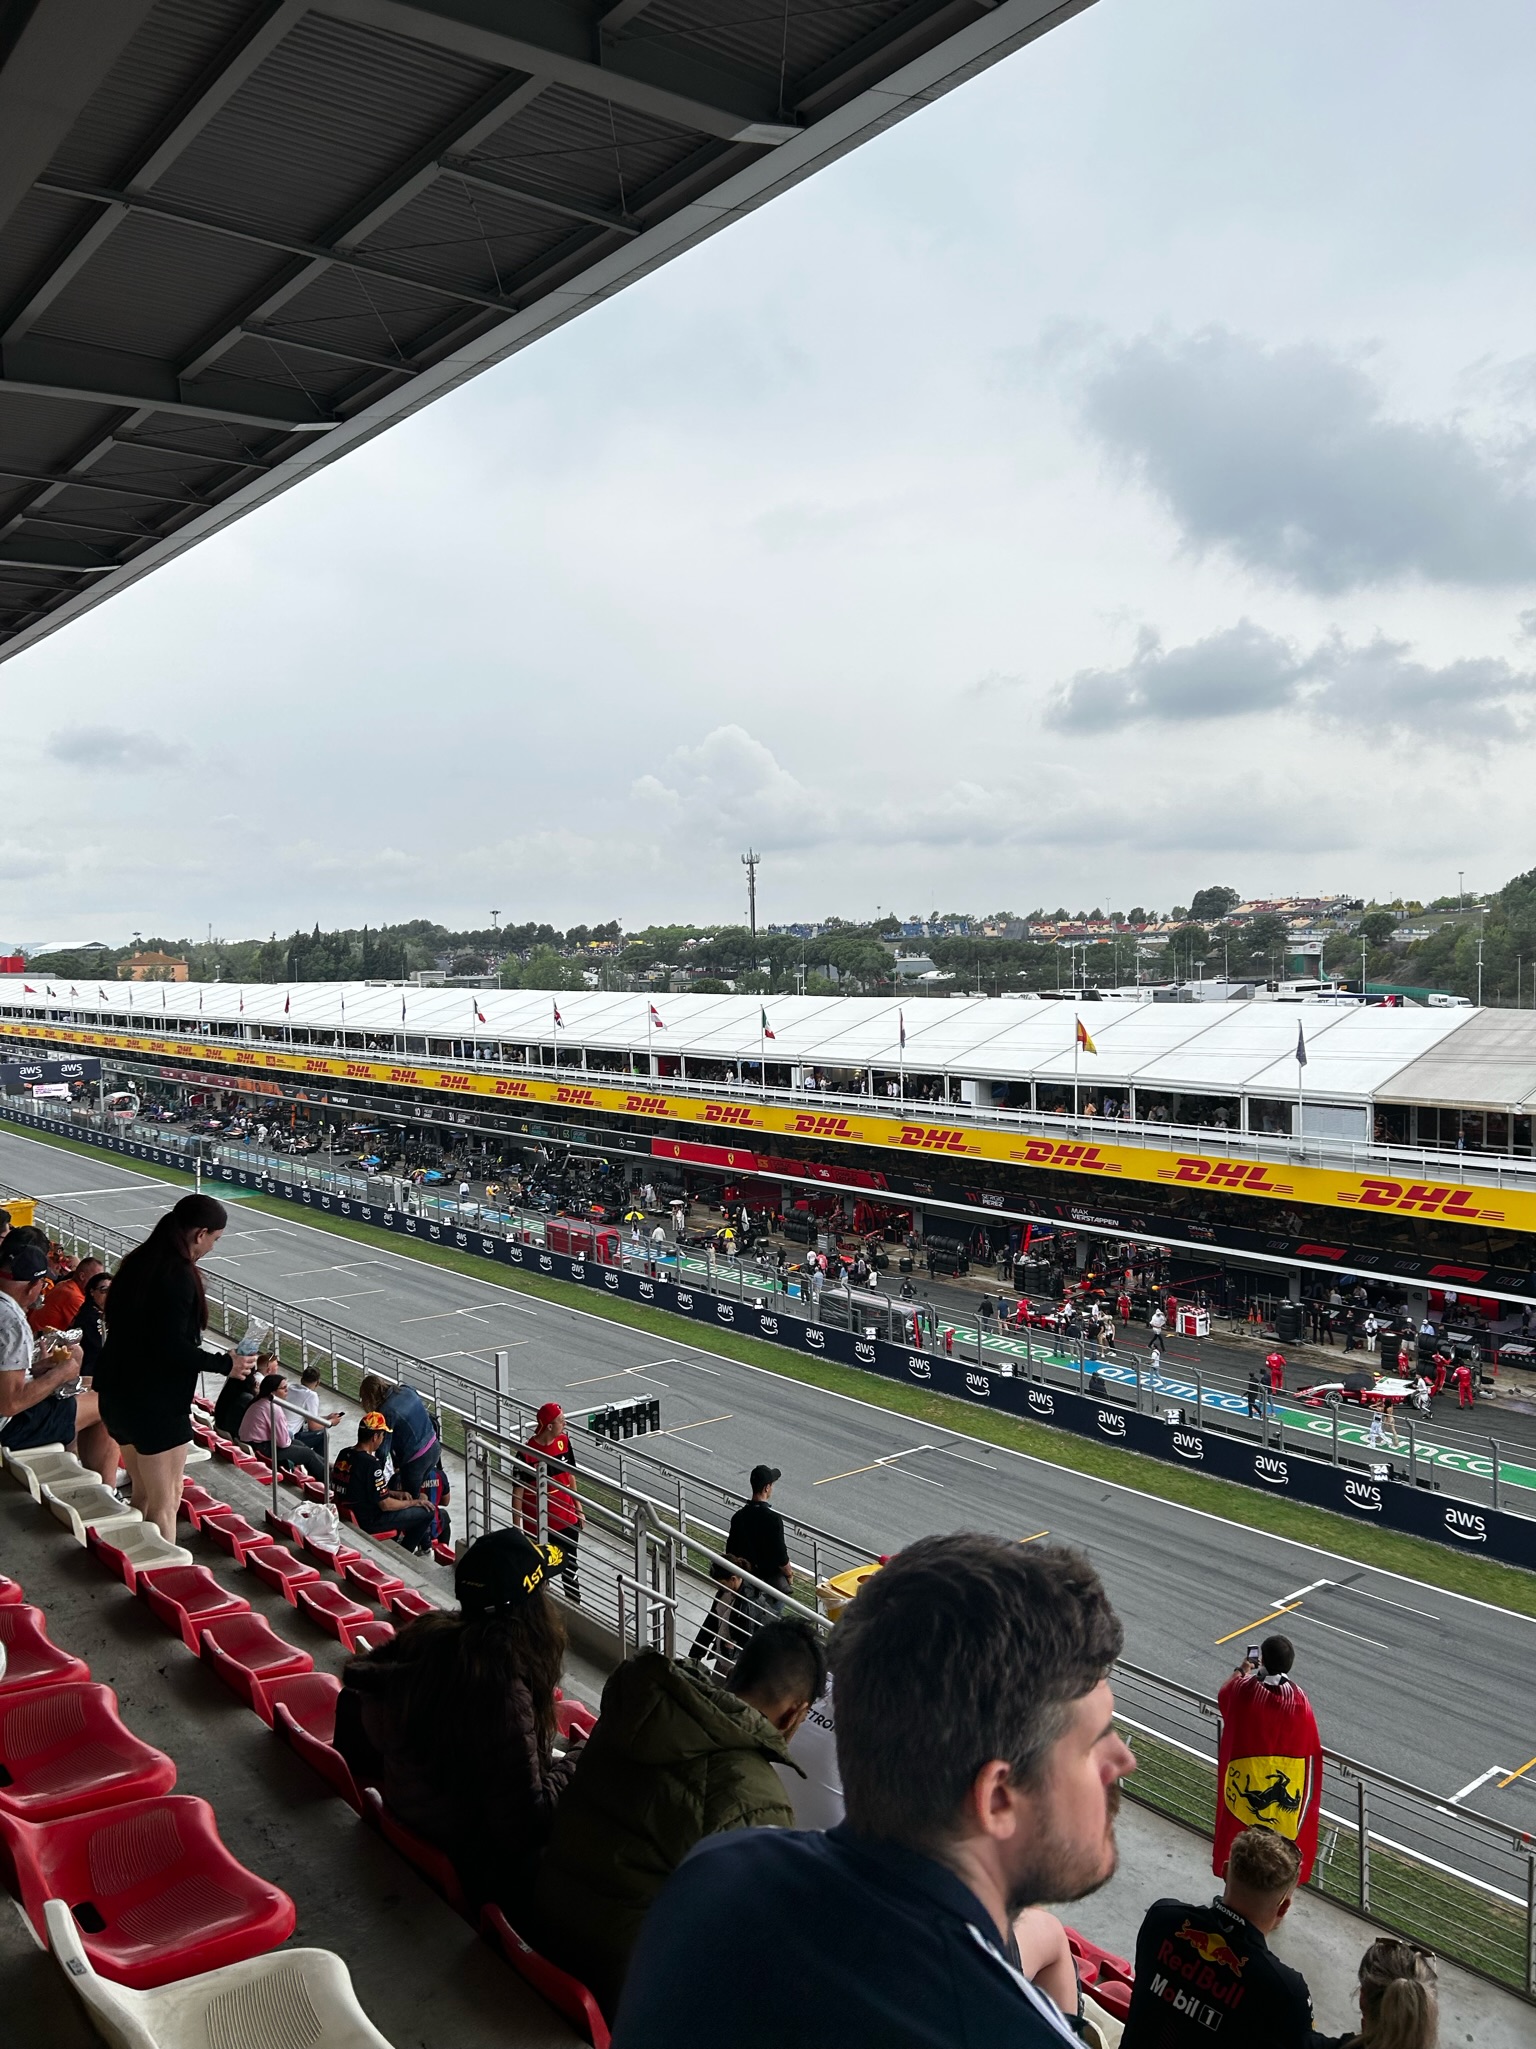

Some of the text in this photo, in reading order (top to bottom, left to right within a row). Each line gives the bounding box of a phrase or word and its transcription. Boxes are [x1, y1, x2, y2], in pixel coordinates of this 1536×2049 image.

[205, 1048, 223, 1060] DHL
[236, 1052, 256, 1064] DHL
[19, 1066, 42, 1075] aws
[61, 1063, 83, 1072] aws
[305, 1060, 329, 1073] DHL
[346, 1064, 373, 1078] DHL
[391, 1069, 419, 1083] DHL
[440, 1074, 471, 1090] DHL
[495, 1080, 529, 1097] DHL
[557, 1087, 595, 1106] DHL
[626, 1095, 670, 1115] DHL
[705, 1104, 754, 1126] DHL
[795, 1114, 852, 1138] DHL
[900, 1126, 968, 1152] DHL
[1024, 1140, 1105, 1170] DHL
[1174, 1158, 1274, 1191] DHL
[981, 1193, 1005, 1202] SERGIO
[1358, 1179, 1481, 1218] DHL
[1071, 1207, 1089, 1215] MAX
[1071, 1212, 1119, 1226] VERSTAPPEN
[456, 1231, 467, 1241] aws
[1187, 1225, 1214, 1233] ORACLE
[482, 1238, 494, 1249] aws
[510, 1246, 523, 1257] aws
[539, 1254, 552, 1265] aws
[571, 1262, 584, 1274] aws
[604, 1271, 619, 1283] aws
[639, 1281, 654, 1293] aws
[677, 1291, 693, 1304] aws
[717, 1302, 734, 1316] aws
[760, 1314, 778, 1328] aws
[805, 1327, 824, 1342] aws
[855, 1341, 875, 1356] aws
[908, 1356, 930, 1371] aws
[966, 1372, 989, 1388] aws
[1096, 1367, 1249, 1409] aramco
[1028, 1389, 1054, 1407] aws
[1098, 1409, 1125, 1428] aws
[1168, 1410, 1180, 1418] 12
[1173, 1431, 1203, 1451] aws
[1255, 1454, 1288, 1475] aws
[1373, 1465, 1389, 1474] 24
[1345, 1479, 1381, 1501] aws
[1445, 1507, 1485, 1531] aws
[1214, 1901, 1247, 1927] HONDA
[1156, 1937, 1246, 2010] Red Bull
[1149, 1972, 1201, 2019] Mobil
